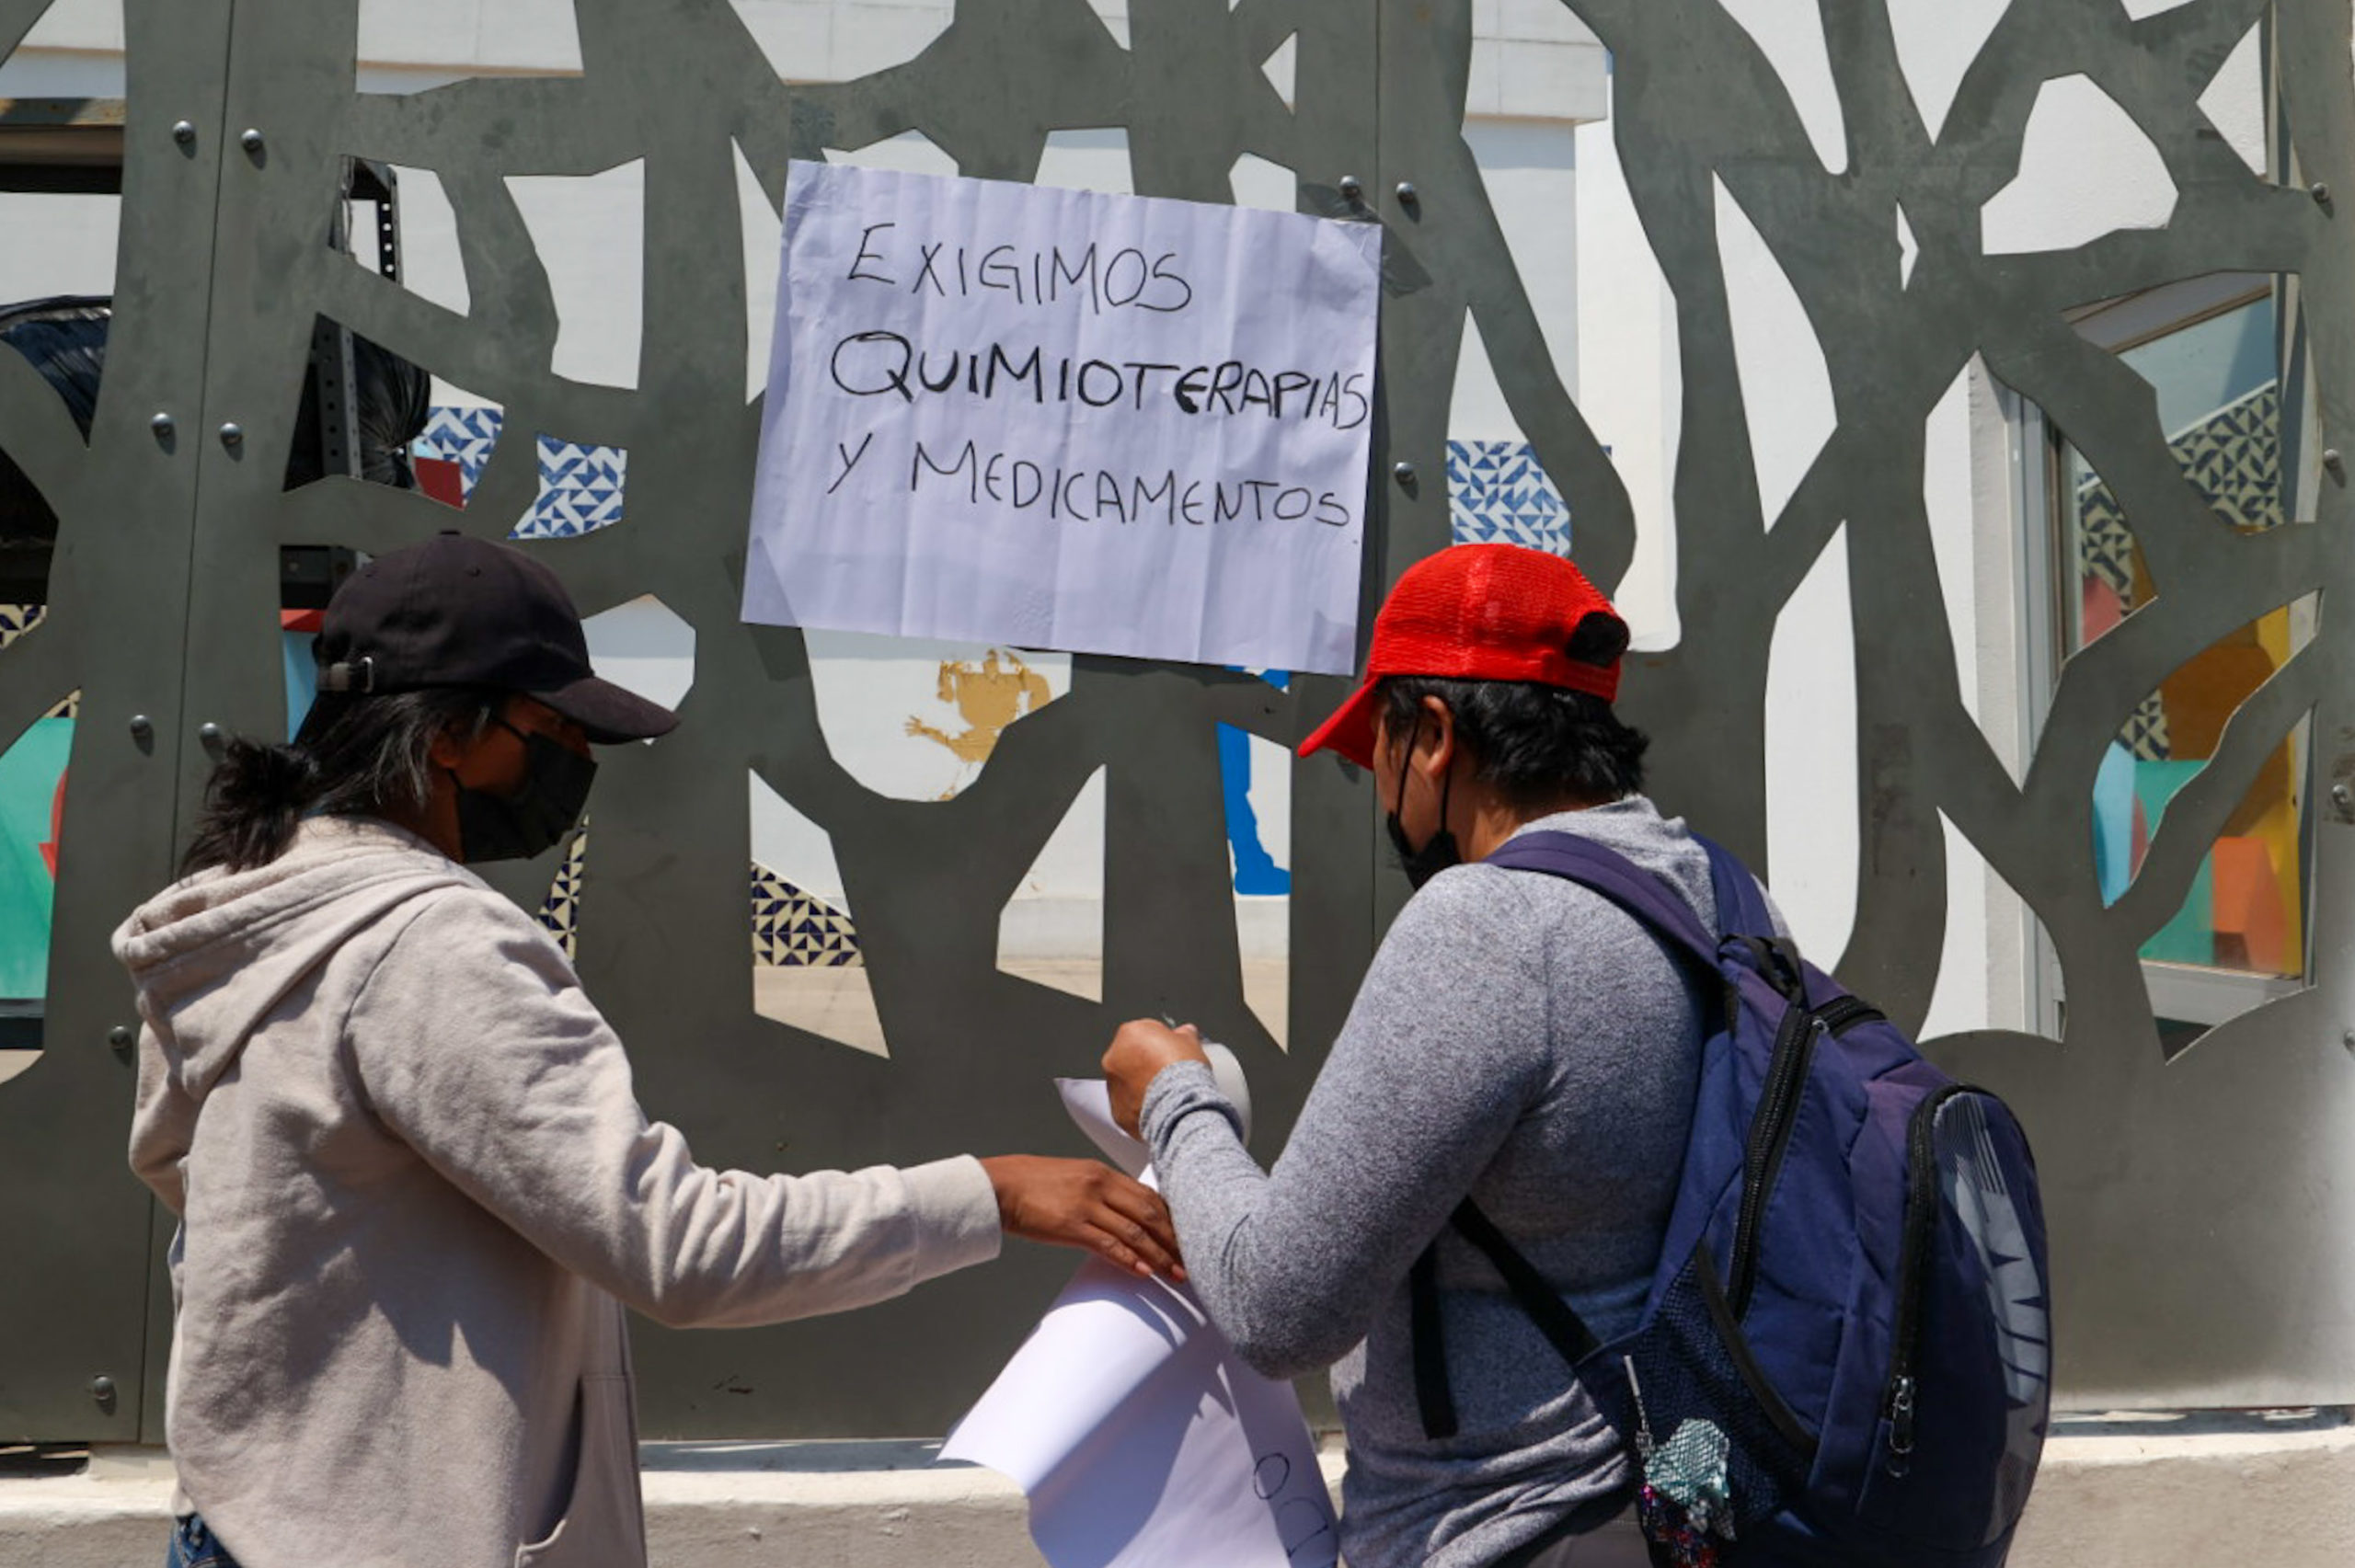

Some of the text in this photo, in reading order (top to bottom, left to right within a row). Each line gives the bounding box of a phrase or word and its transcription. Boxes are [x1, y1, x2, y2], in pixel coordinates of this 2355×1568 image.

[847, 223, 1191, 314] EXIGIMOS
[831, 330, 1368, 429] QUIMIOTERAPIAS
[912, 440, 1350, 526] MEDICAMENTOS
